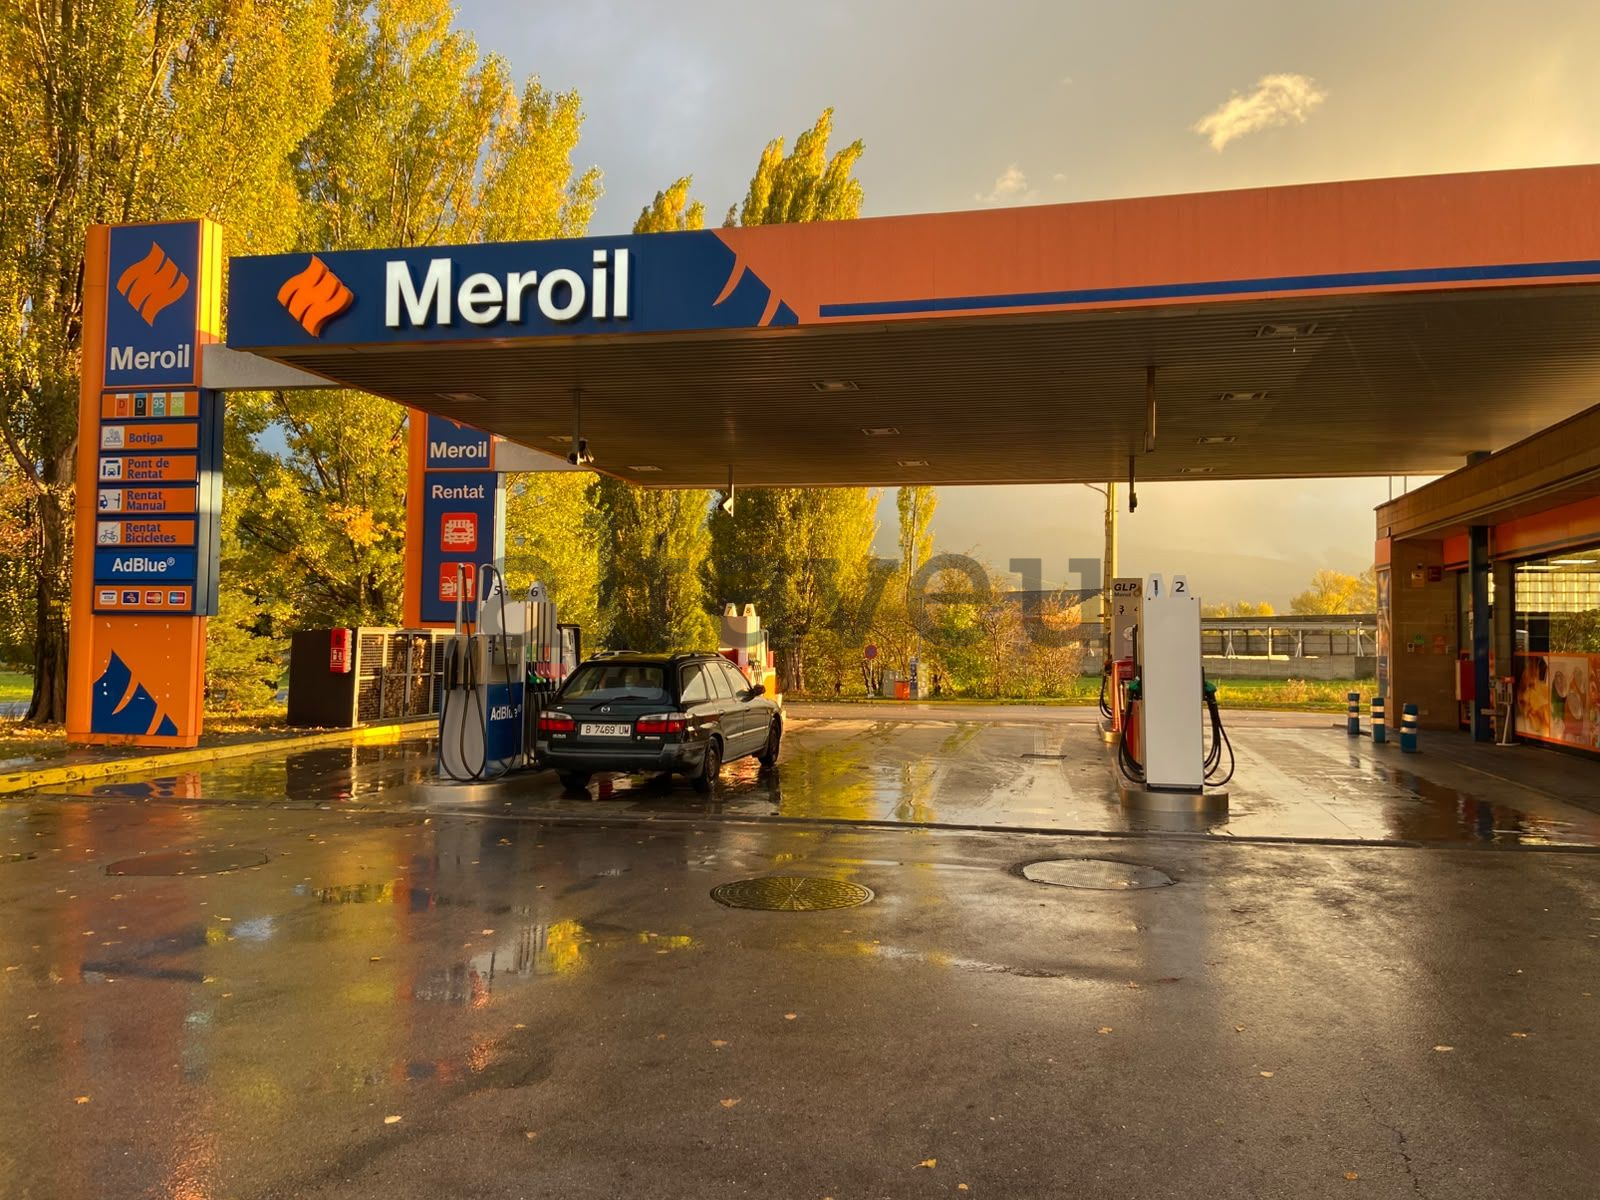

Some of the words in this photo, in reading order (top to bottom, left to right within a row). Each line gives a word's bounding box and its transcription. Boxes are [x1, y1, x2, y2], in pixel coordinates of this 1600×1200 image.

[385, 248, 630, 328] Meroil
[110, 344, 190, 370] Meroil
[136, 399, 144, 408] D
[153, 399, 165, 408] 95
[129, 432, 163, 445] Botiga
[430, 441, 487, 458] Meroil
[127, 458, 152, 468] Pont
[156, 458, 169, 468] de
[127, 469, 162, 479] Rentat
[127, 490, 162, 500] Rentat
[432, 484, 484, 499] Rentat
[126, 501, 166, 511] Manual
[126, 523, 160, 532] Rentat
[125, 532, 176, 543] Bicicletes
[493, 585, 501, 596] 5
[1113, 583, 1137, 592] GLP
[1152, 579, 1159, 592] 1
[1175, 581, 1185, 593] 2
[530, 586, 539, 597] 6
[585, 725, 592, 734] B
[594, 725, 616, 734] 7469
